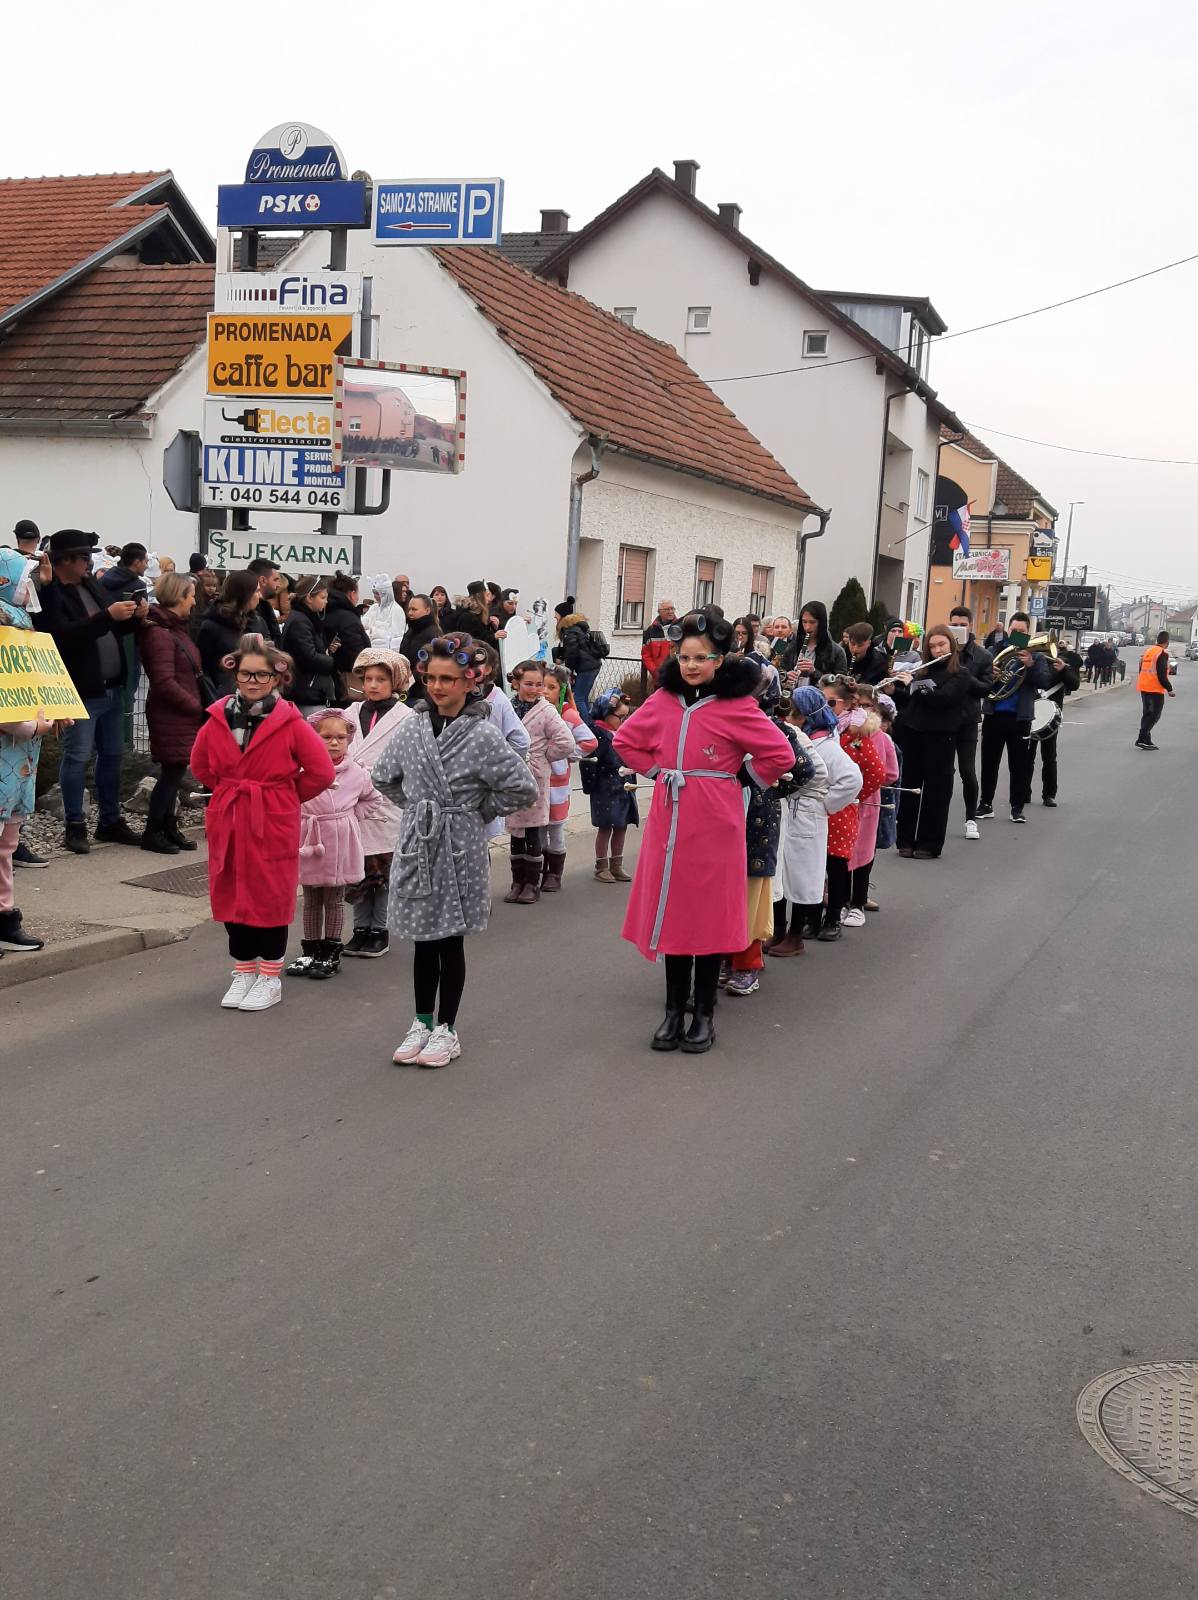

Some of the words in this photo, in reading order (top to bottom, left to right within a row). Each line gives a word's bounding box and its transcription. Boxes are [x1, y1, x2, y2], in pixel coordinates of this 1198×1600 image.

[250, 152, 337, 180] Promenada
[259, 194, 305, 213] PSK
[380, 192, 404, 214] SAMO
[405, 192, 416, 213] ZA
[418, 191, 458, 213] STRANKE
[467, 189, 491, 233] P
[279, 276, 348, 306] Fina
[214, 322, 332, 342] PROMENADA
[213, 354, 279, 388] caffe
[285, 354, 333, 388] bar
[258, 408, 331, 435] Electa
[223, 436, 328, 446] elektroinstalacije
[208, 447, 299, 485] KLIME
[304, 476, 342, 486] MONTAŽA
[208, 486, 224, 501] T:
[230, 487, 262, 502] 040
[269, 489, 301, 505] 544
[307, 490, 340, 506] 046
[229, 541, 350, 565] LJEKARNA
[0, 644, 66, 676] ORETKINJE
